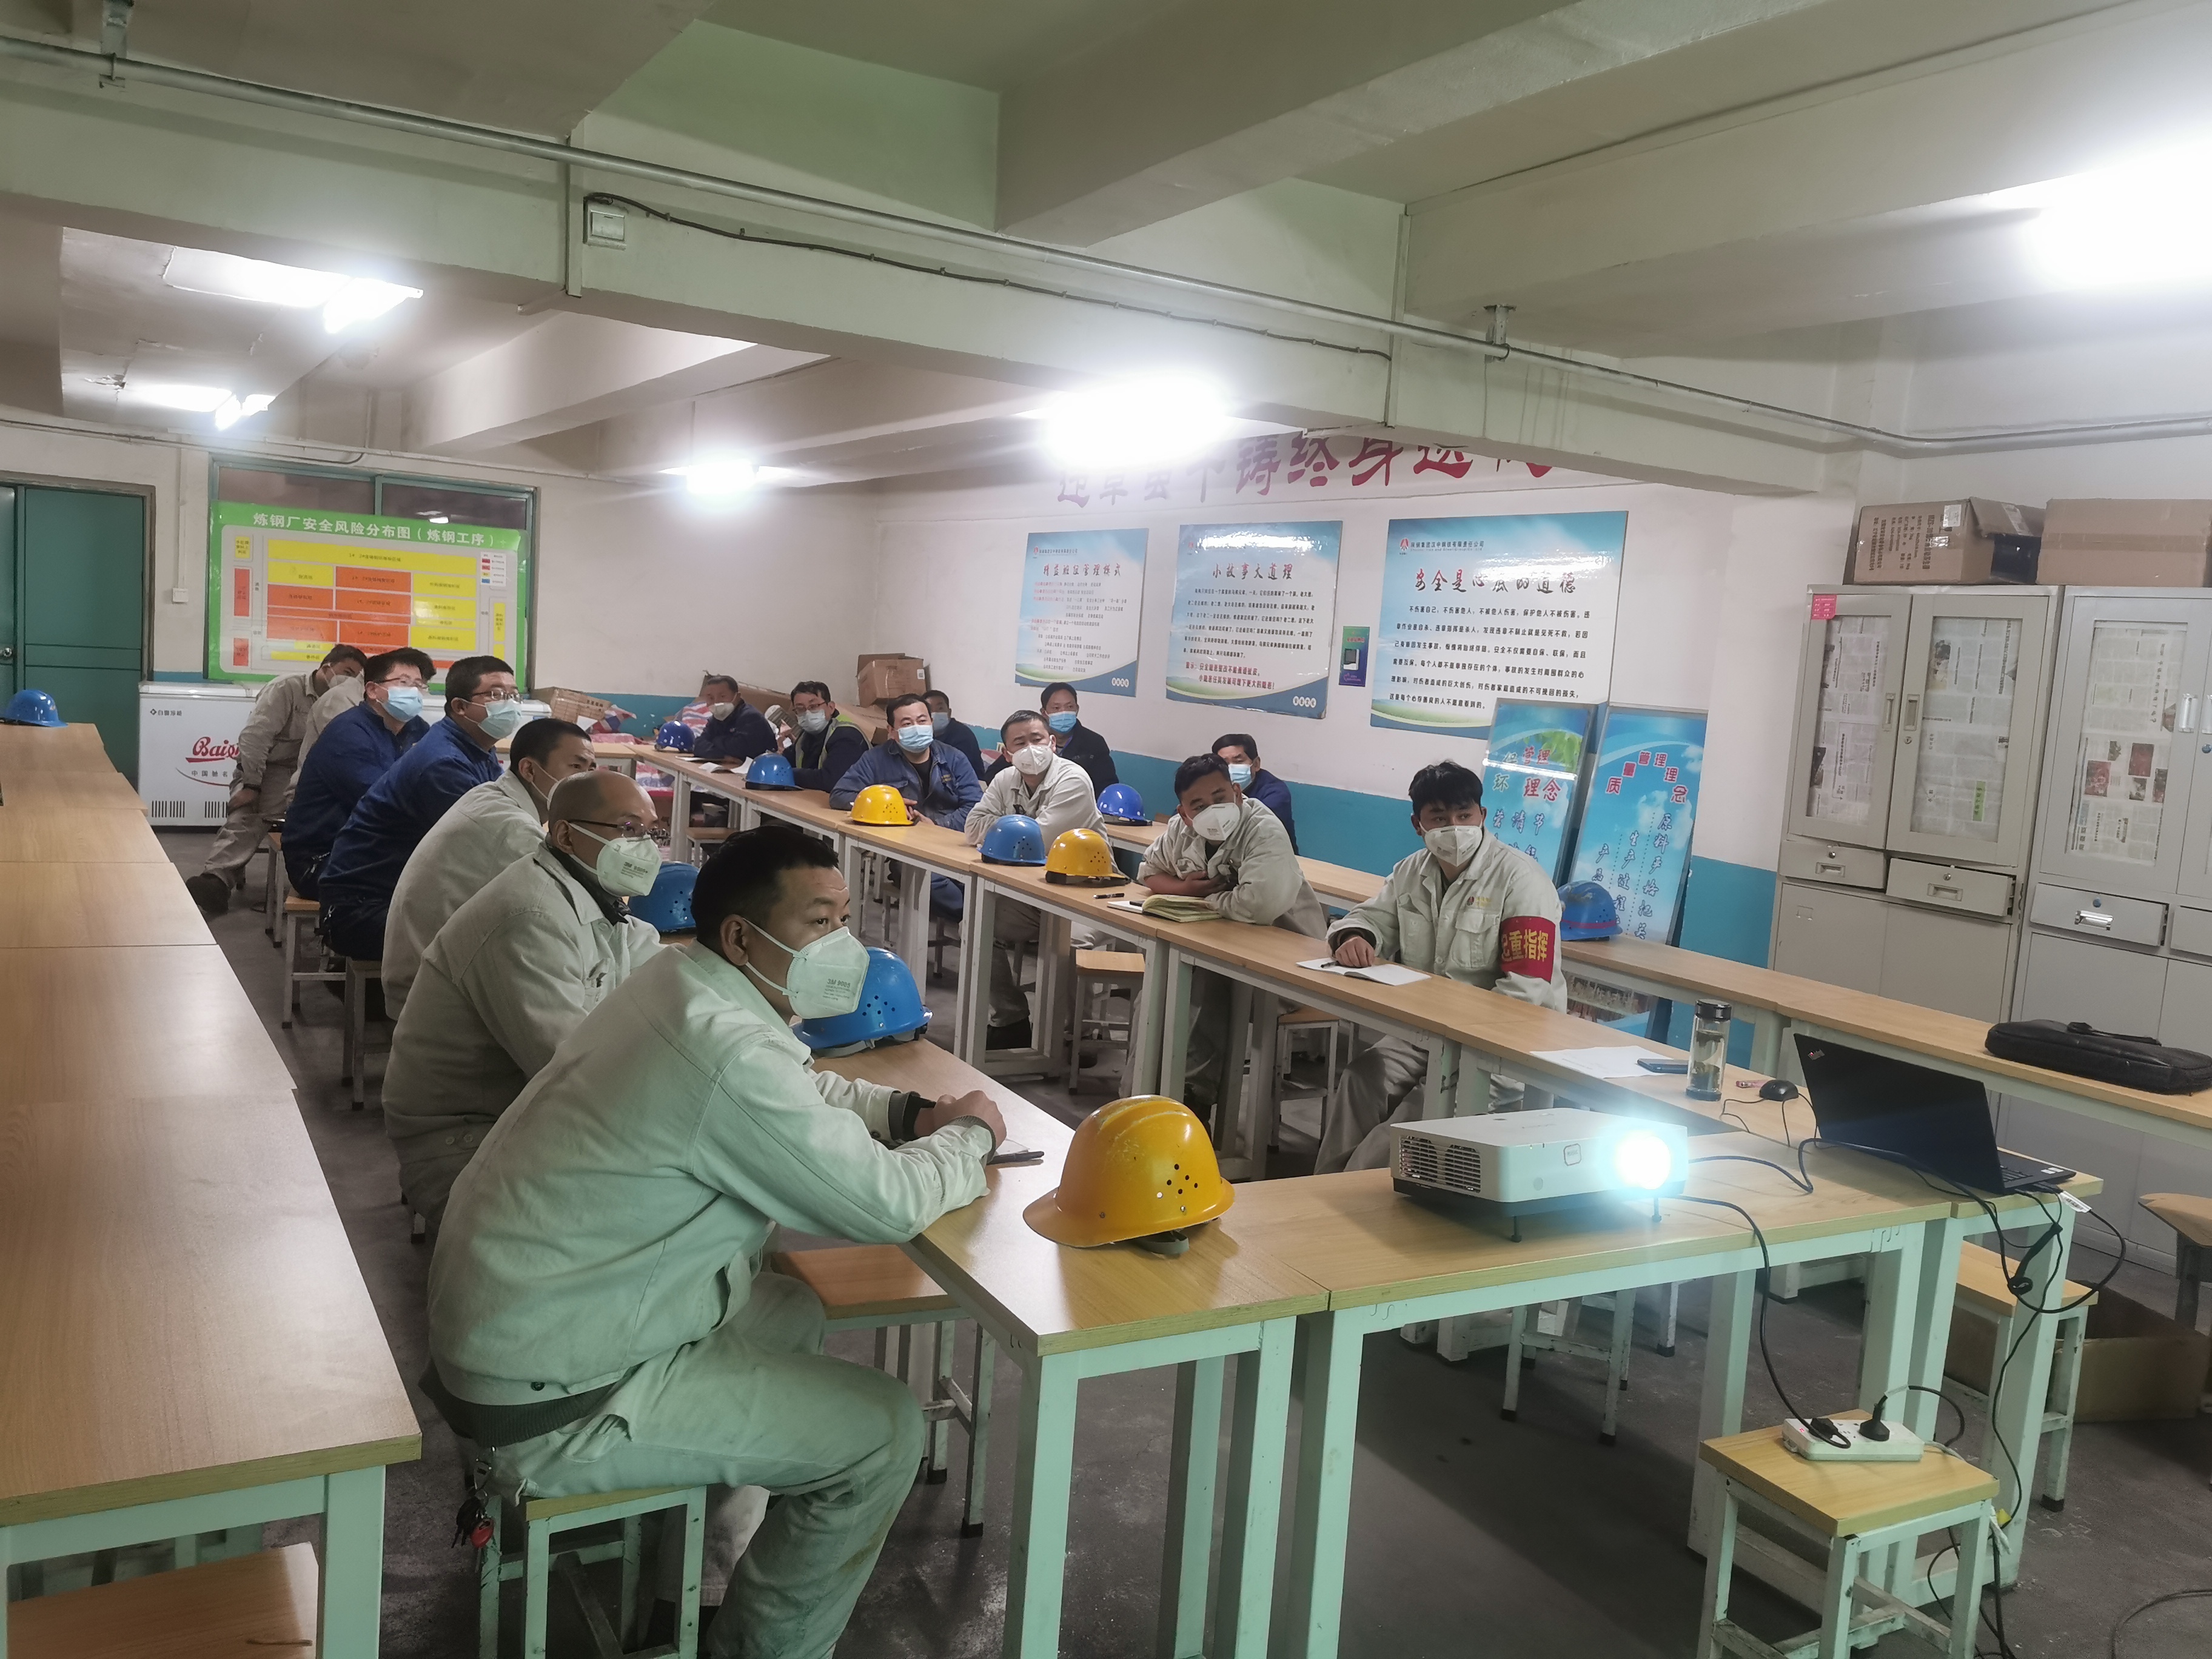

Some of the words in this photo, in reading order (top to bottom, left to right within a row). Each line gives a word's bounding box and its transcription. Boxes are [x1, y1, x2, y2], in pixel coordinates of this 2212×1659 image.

[253, 512, 494, 547] 炼钢厂安全风险分布图（炼钢工序）
[1213, 563, 1293, 580] 小故事大道理
[1523, 746, 1550, 765] 管理
[1523, 777, 1562, 802] 理念
[1592, 843, 1610, 882] 产品
[1634, 813, 1672, 940] 原料严格把关
